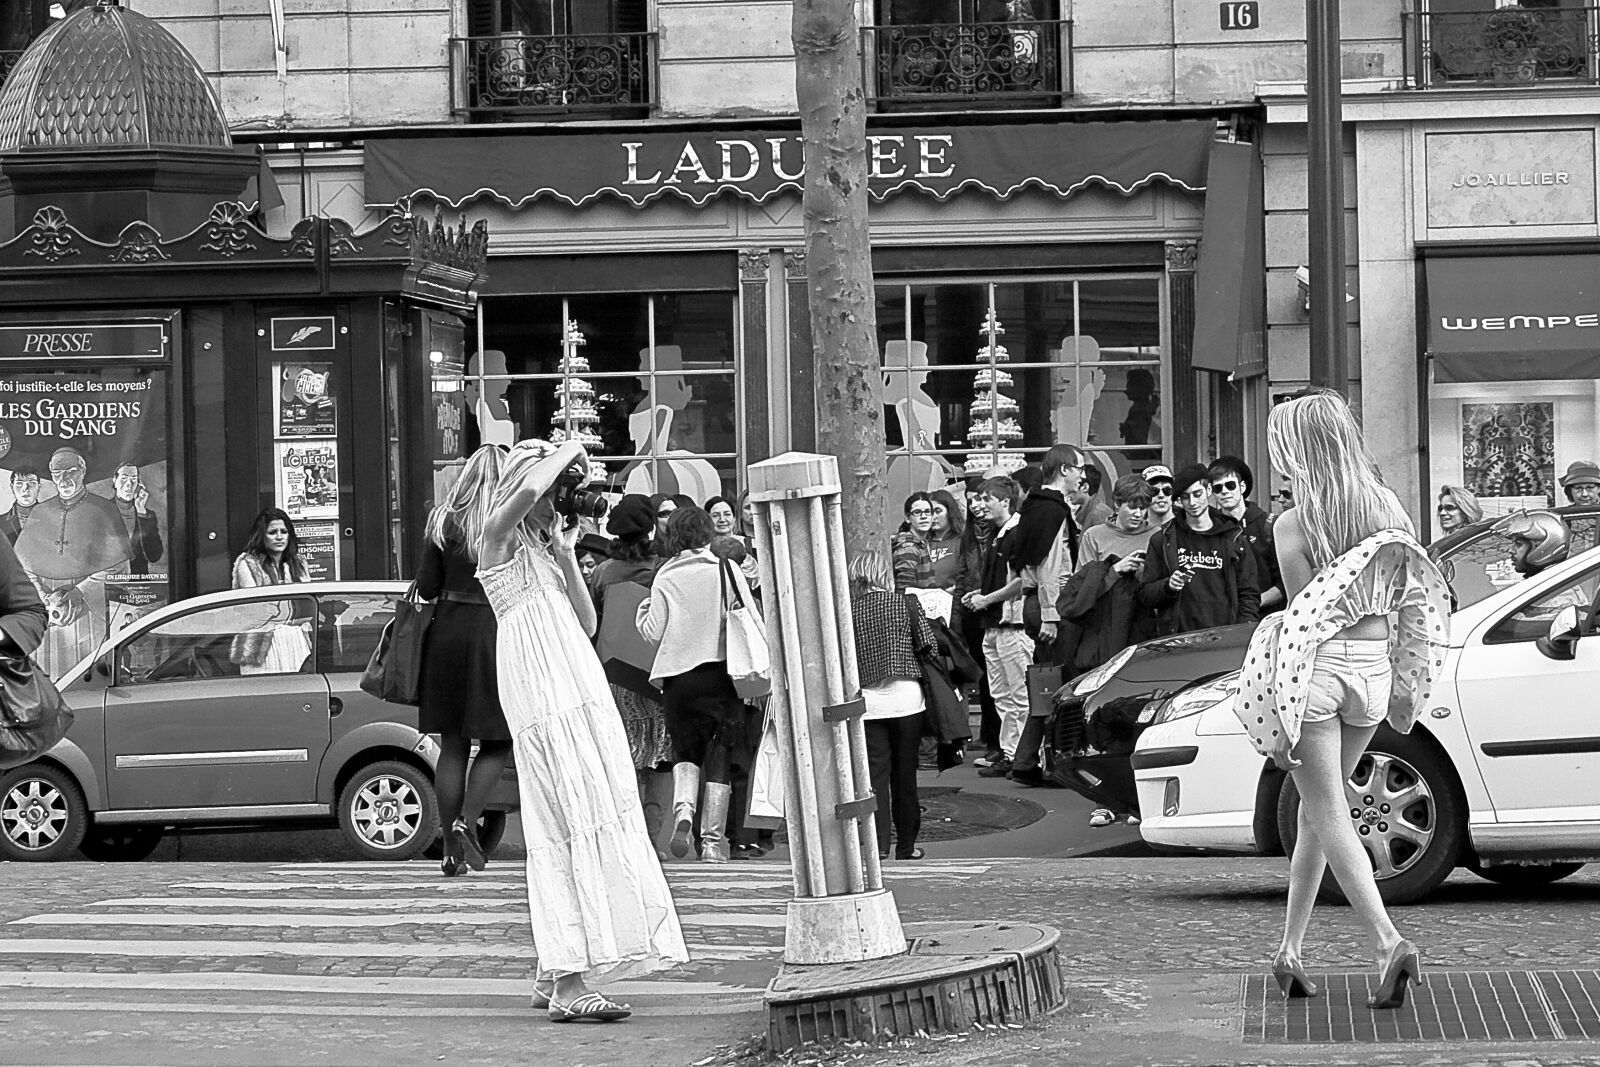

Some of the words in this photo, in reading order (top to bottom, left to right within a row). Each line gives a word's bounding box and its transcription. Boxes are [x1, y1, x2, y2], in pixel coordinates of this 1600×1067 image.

[1228, 4, 1252, 27] 16
[622, 134, 956, 185] LADUEE
[1452, 171, 1569, 188] JOAILLIER
[1441, 314, 1599, 330] WEMPE
[23, 333, 93, 357] PRESSE
[15, 380, 85, 393] justifie-t-elle
[86, 380, 103, 392] les
[0, 403, 31, 419] LES
[36, 398, 141, 419] GARDIENS
[24, 419, 54, 436] DU
[59, 418, 117, 439] SANG
[297, 545, 335, 553] ENSONGES
